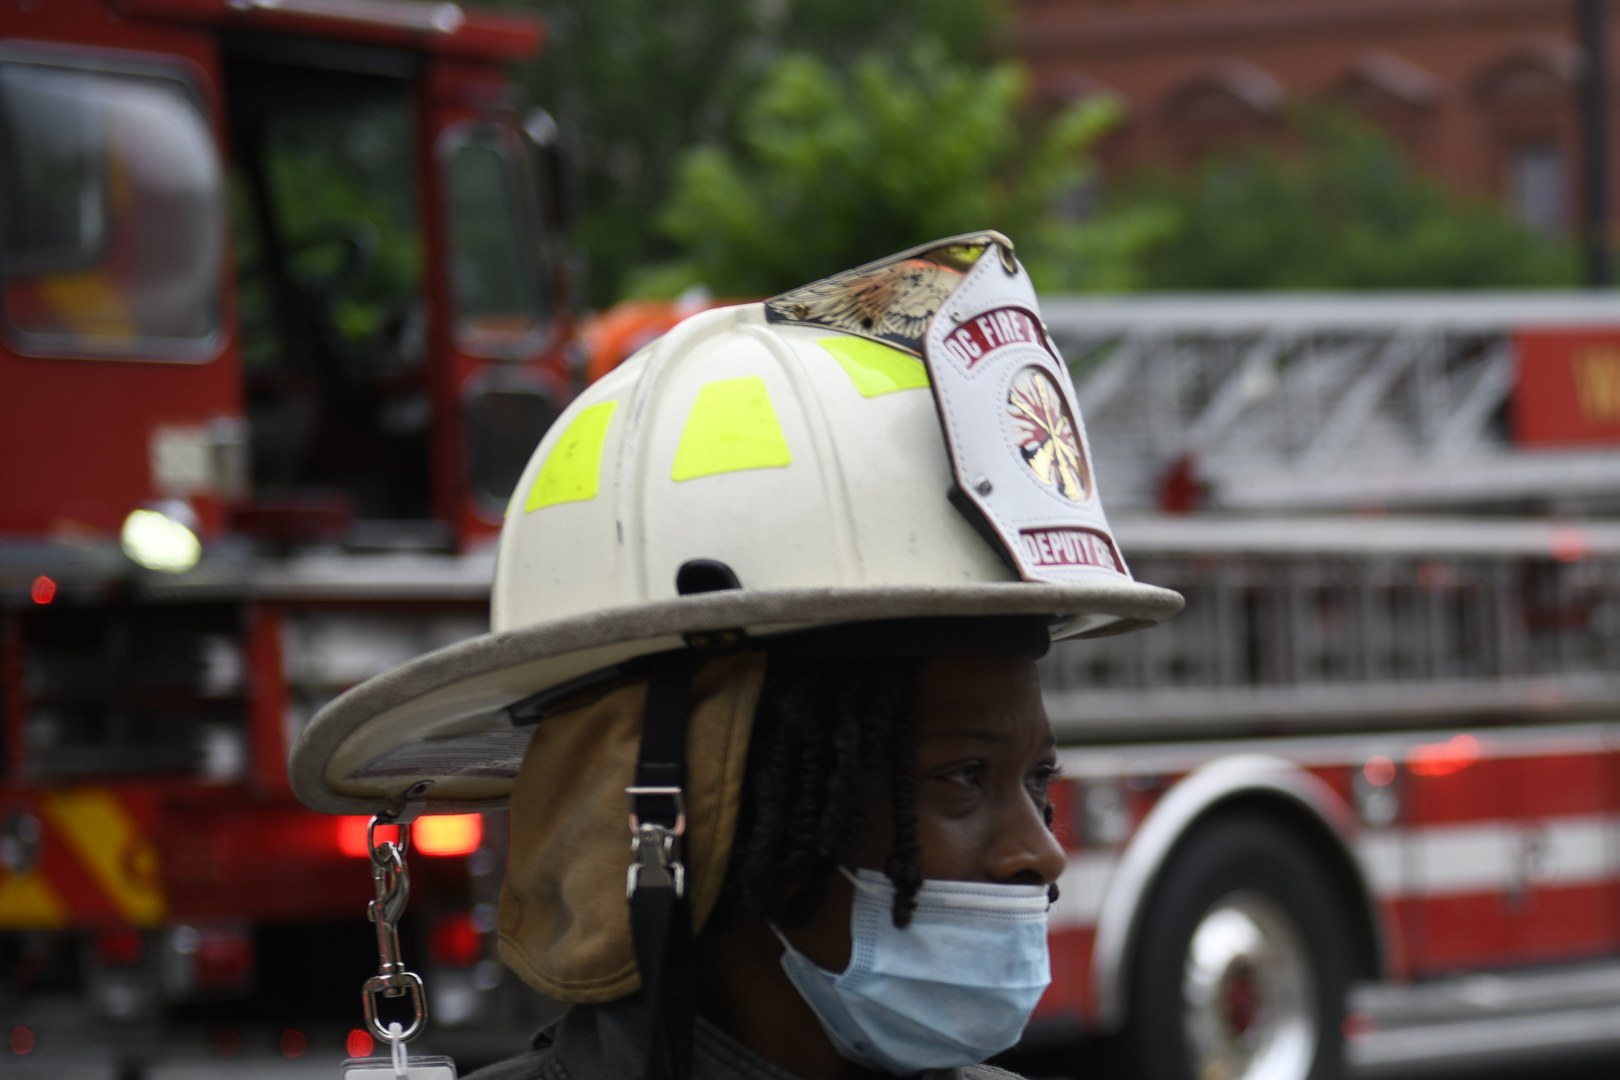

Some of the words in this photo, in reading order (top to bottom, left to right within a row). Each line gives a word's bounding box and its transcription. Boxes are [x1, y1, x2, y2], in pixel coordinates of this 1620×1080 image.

[944, 327, 982, 371] DC
[976, 309, 1025, 348] FIRE
[1020, 530, 1093, 565] DEPUTY
